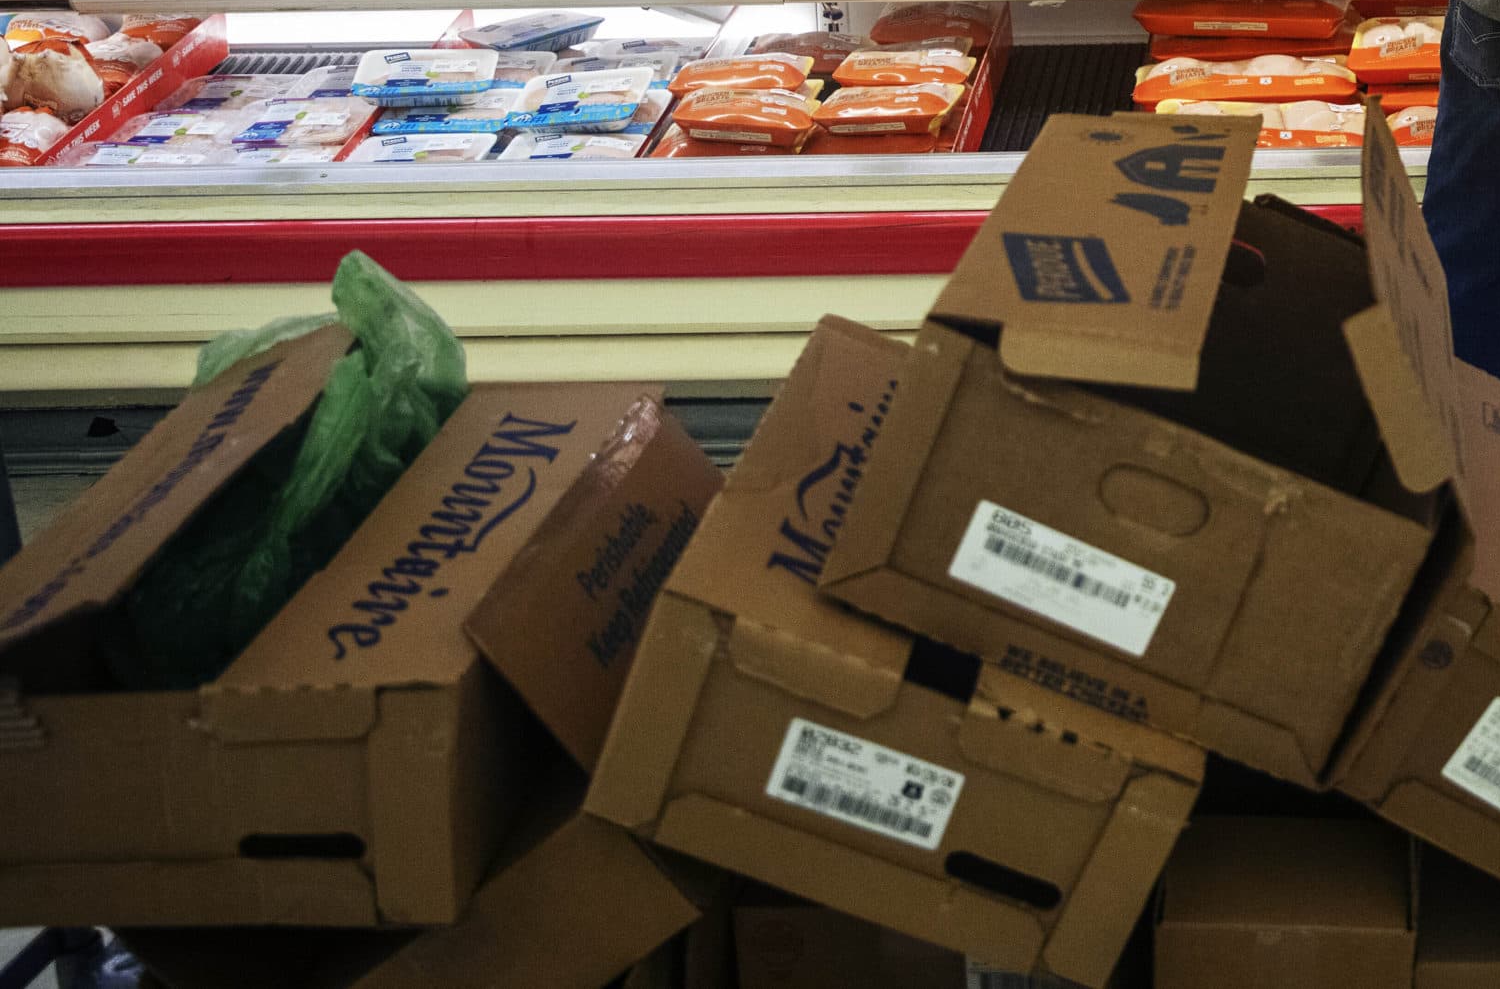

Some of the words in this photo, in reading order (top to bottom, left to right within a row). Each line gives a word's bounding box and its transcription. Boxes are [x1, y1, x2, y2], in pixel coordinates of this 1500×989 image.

[122, 93, 137, 107] SAVE
[136, 80, 149, 95] THIS
[149, 68, 164, 84] WEEK
[84, 119, 101, 138] WEEK
[328, 411, 578, 660] Mountaire
[576, 502, 656, 600] Perishable
